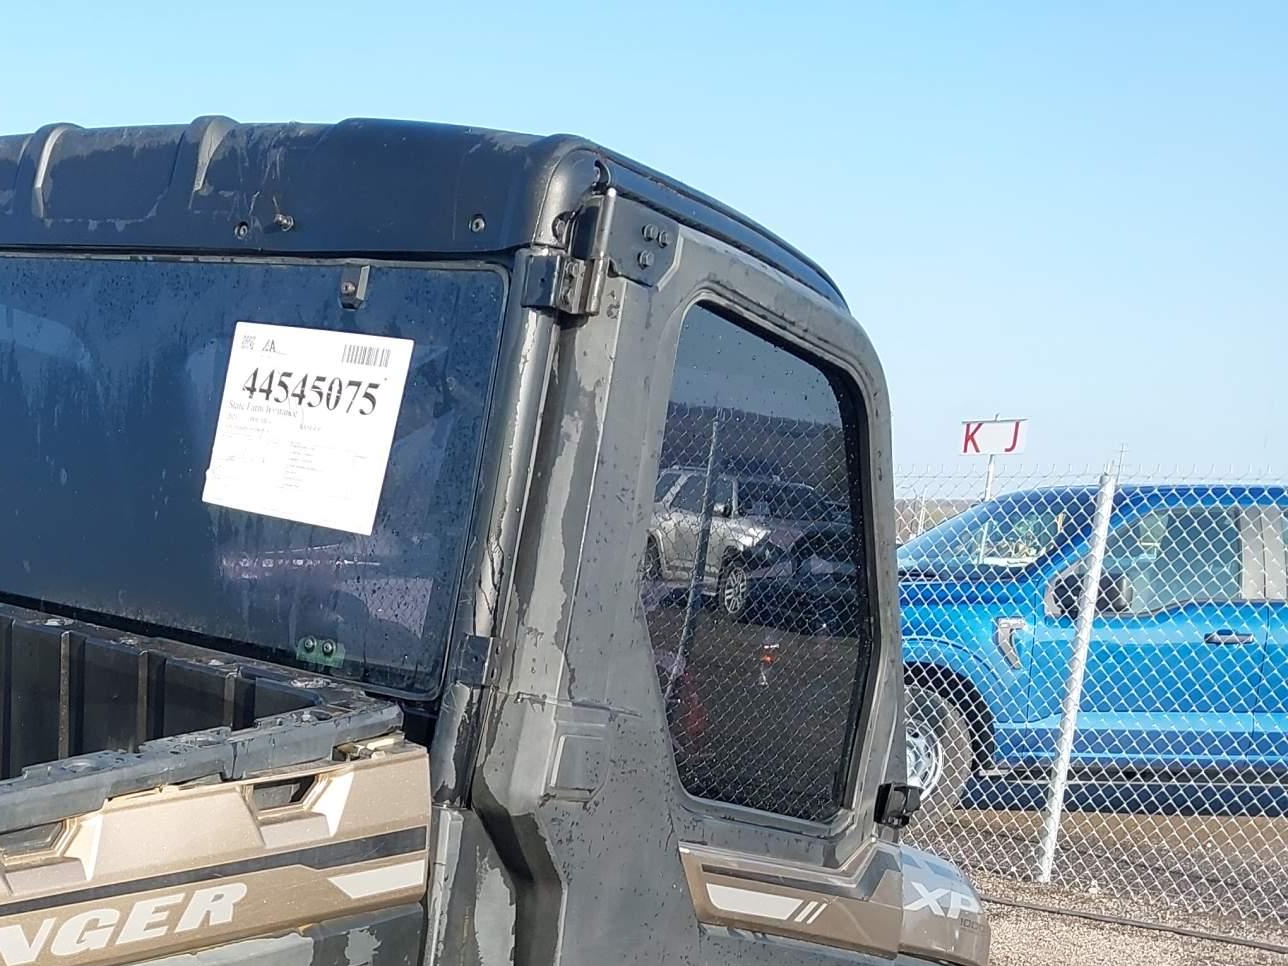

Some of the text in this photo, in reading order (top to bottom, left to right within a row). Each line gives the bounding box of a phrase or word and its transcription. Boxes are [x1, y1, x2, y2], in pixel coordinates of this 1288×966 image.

[242, 367, 380, 415] 44545075
[963, 421, 1020, 453] K J
[903, 881, 984, 919] XP
